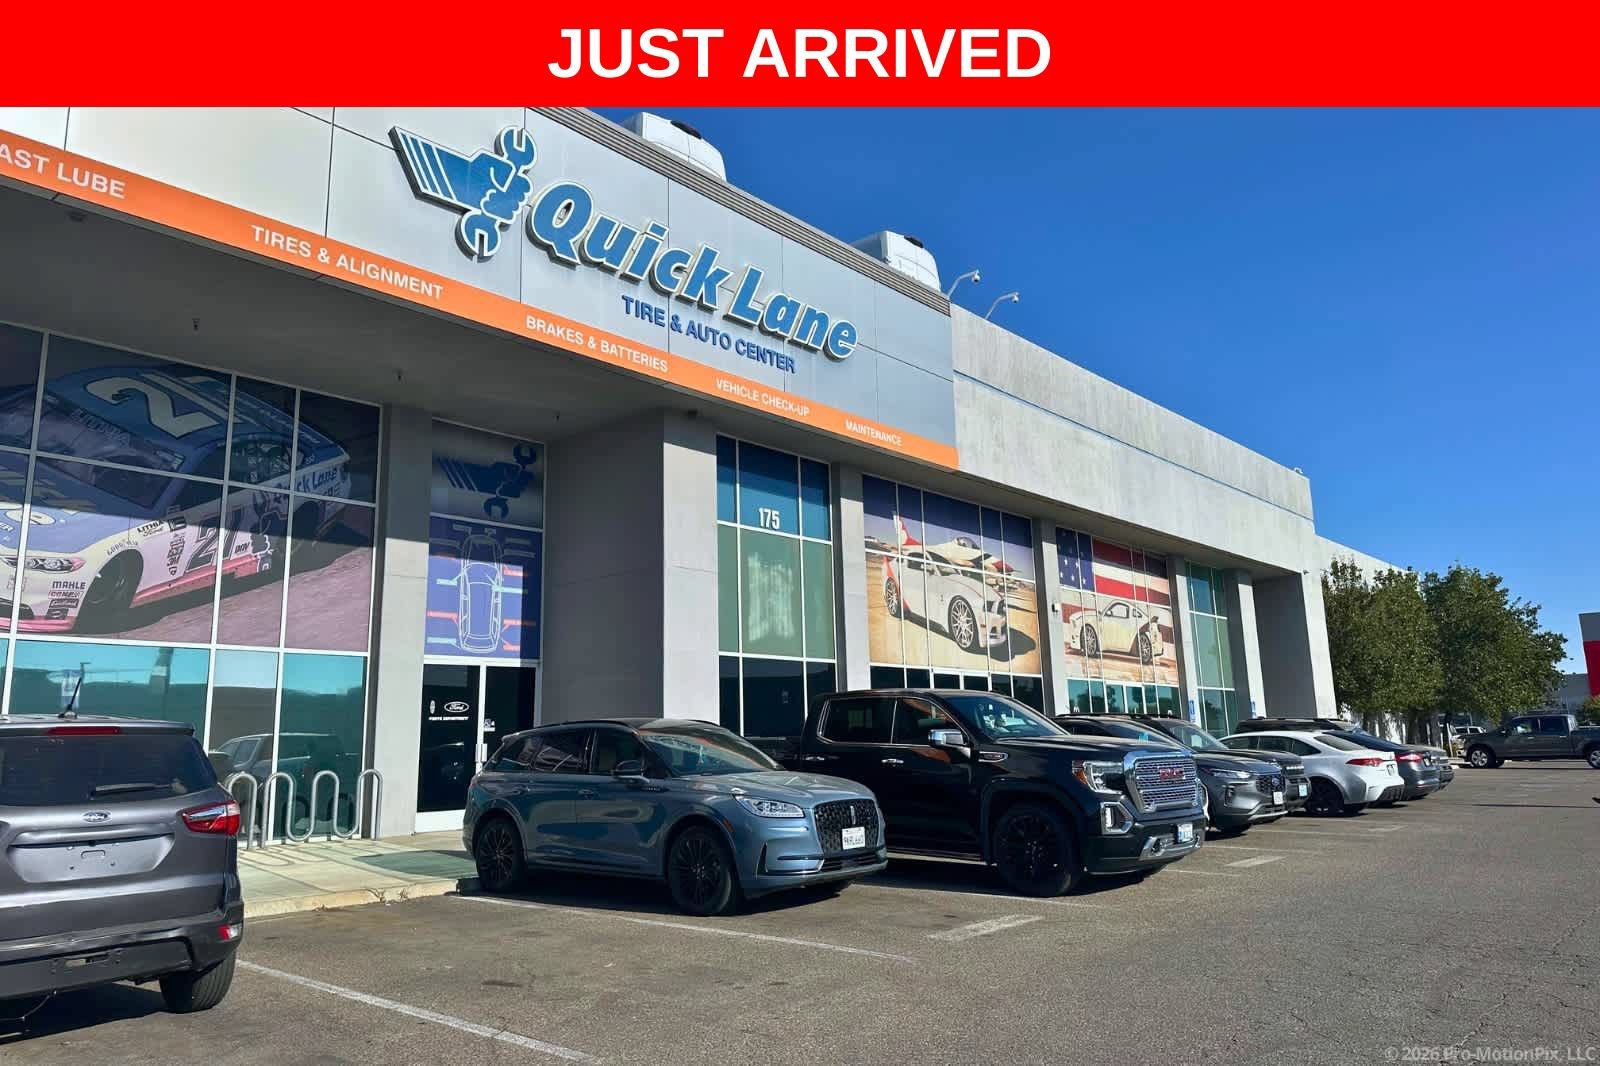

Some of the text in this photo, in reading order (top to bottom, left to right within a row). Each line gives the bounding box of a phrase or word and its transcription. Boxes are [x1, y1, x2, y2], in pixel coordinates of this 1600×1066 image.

[57, 162, 126, 199] LUBE
[251, 225, 444, 300] TIRES & ALIGNMENT
[527, 181, 859, 362] Quick Lane
[526, 314, 669, 373] BRAKES & BATTERIES
[621, 294, 796, 374] TIRE & AUTO CENTER
[715, 377, 811, 418] VEHICLE CHECK-UP
[845, 419, 903, 447] MAINTENANCE
[758, 507, 780, 530] 175
[52, 581, 86, 590] MAHLE
